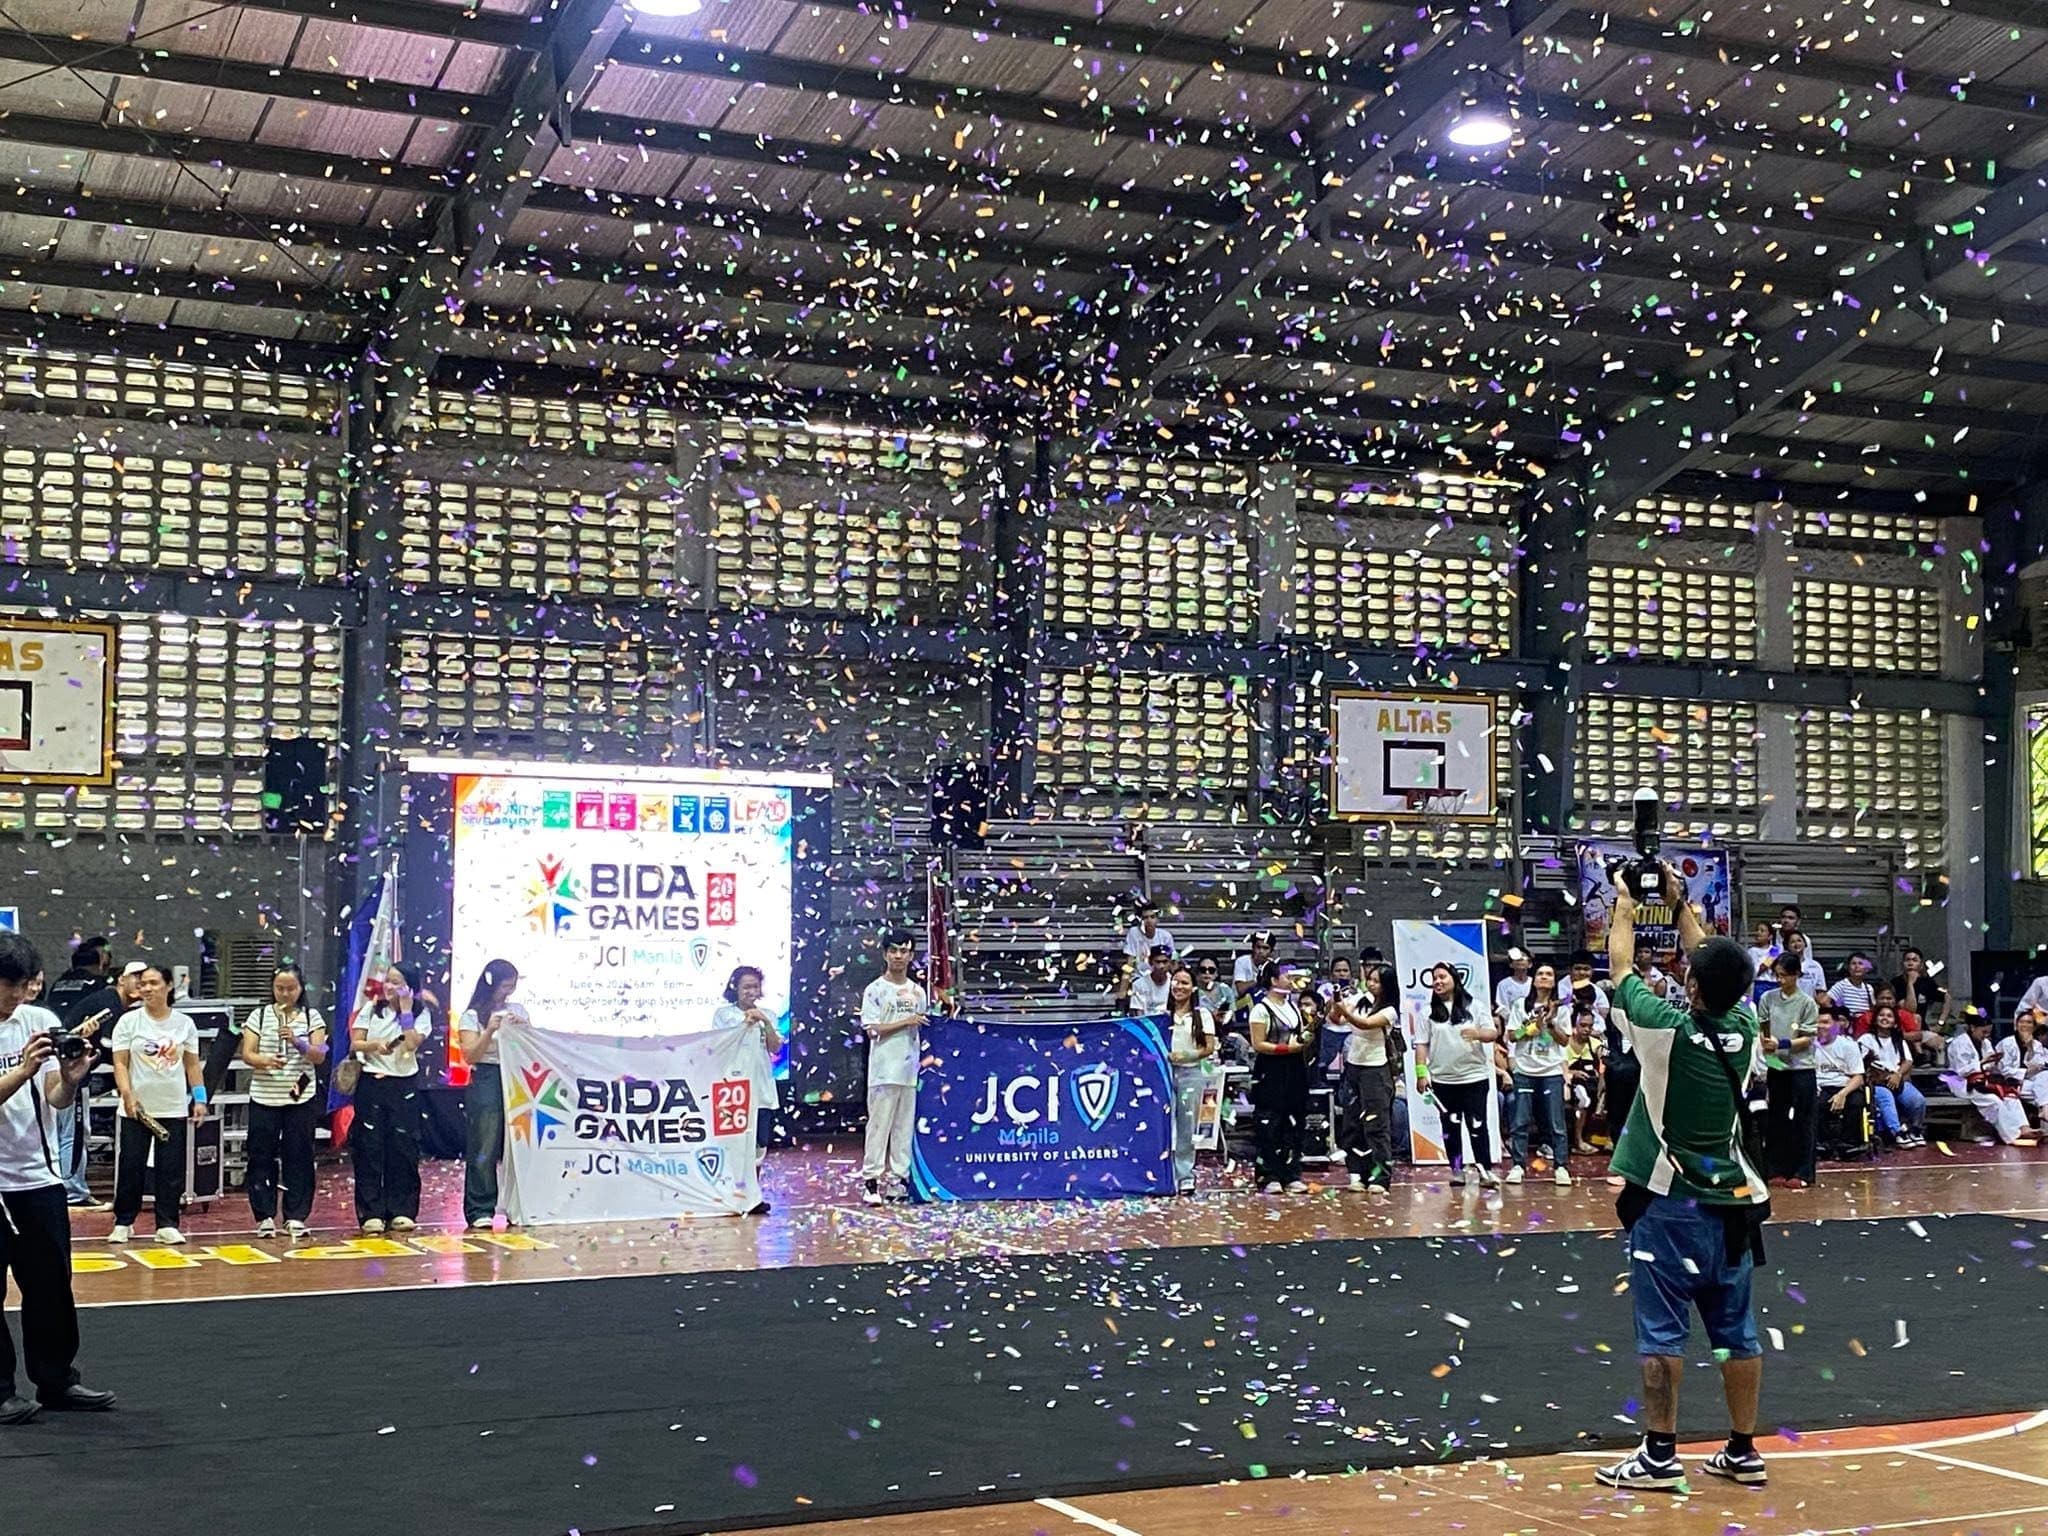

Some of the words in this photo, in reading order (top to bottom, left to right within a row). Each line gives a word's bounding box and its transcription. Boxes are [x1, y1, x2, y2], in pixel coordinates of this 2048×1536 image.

[1377, 708, 1452, 734] ALTAS
[591, 863, 696, 900] BIDA
[589, 905, 699, 931] GAMES
[709, 901, 732, 921] 26
[595, 946, 626, 967] JCI
[633, 949, 683, 964] Manila
[1406, 968, 1434, 989] JC
[576, 1078, 700, 1114] BIDA
[718, 1086, 745, 1107] 20
[970, 1075, 1059, 1124] JCI
[575, 1113, 707, 1144] GAMES
[719, 1109, 747, 1131] 26
[999, 1127, 1060, 1145] Manila
[582, 1154, 620, 1175] JCI
[627, 1158, 689, 1176] Manila
[966, 1152, 1038, 1163] UNIVERSITY
[1044, 1150, 1059, 1161] OF
[1064, 1148, 1119, 1161] LEADERS
